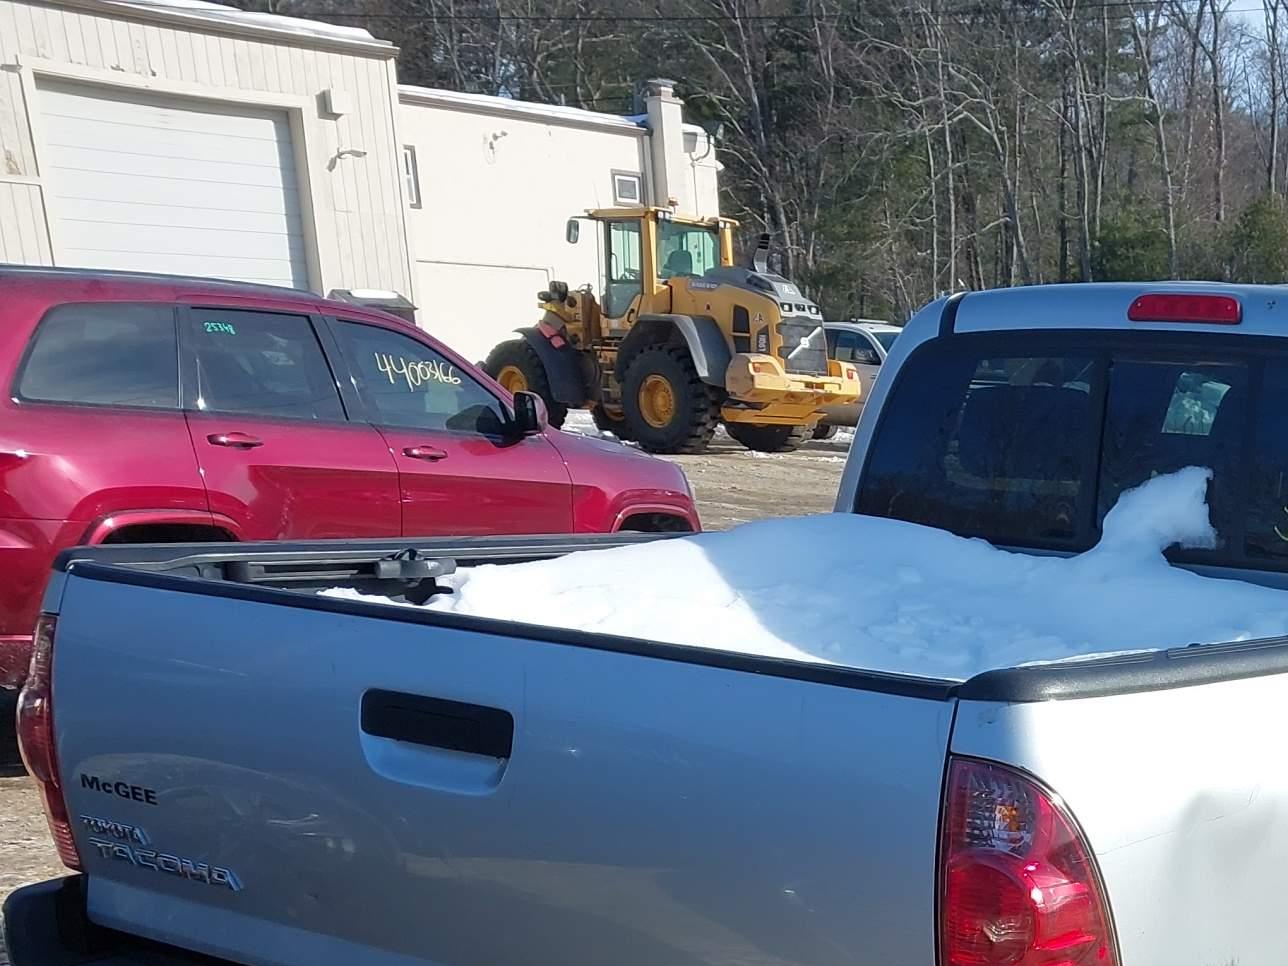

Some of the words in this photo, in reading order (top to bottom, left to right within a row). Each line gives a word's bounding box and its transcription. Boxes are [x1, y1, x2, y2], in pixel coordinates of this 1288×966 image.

[374, 352, 461, 392] 44003166
[80, 773, 158, 806] McGEE
[80, 814, 150, 846] TOYOTA
[88, 836, 244, 892] TACOMA
